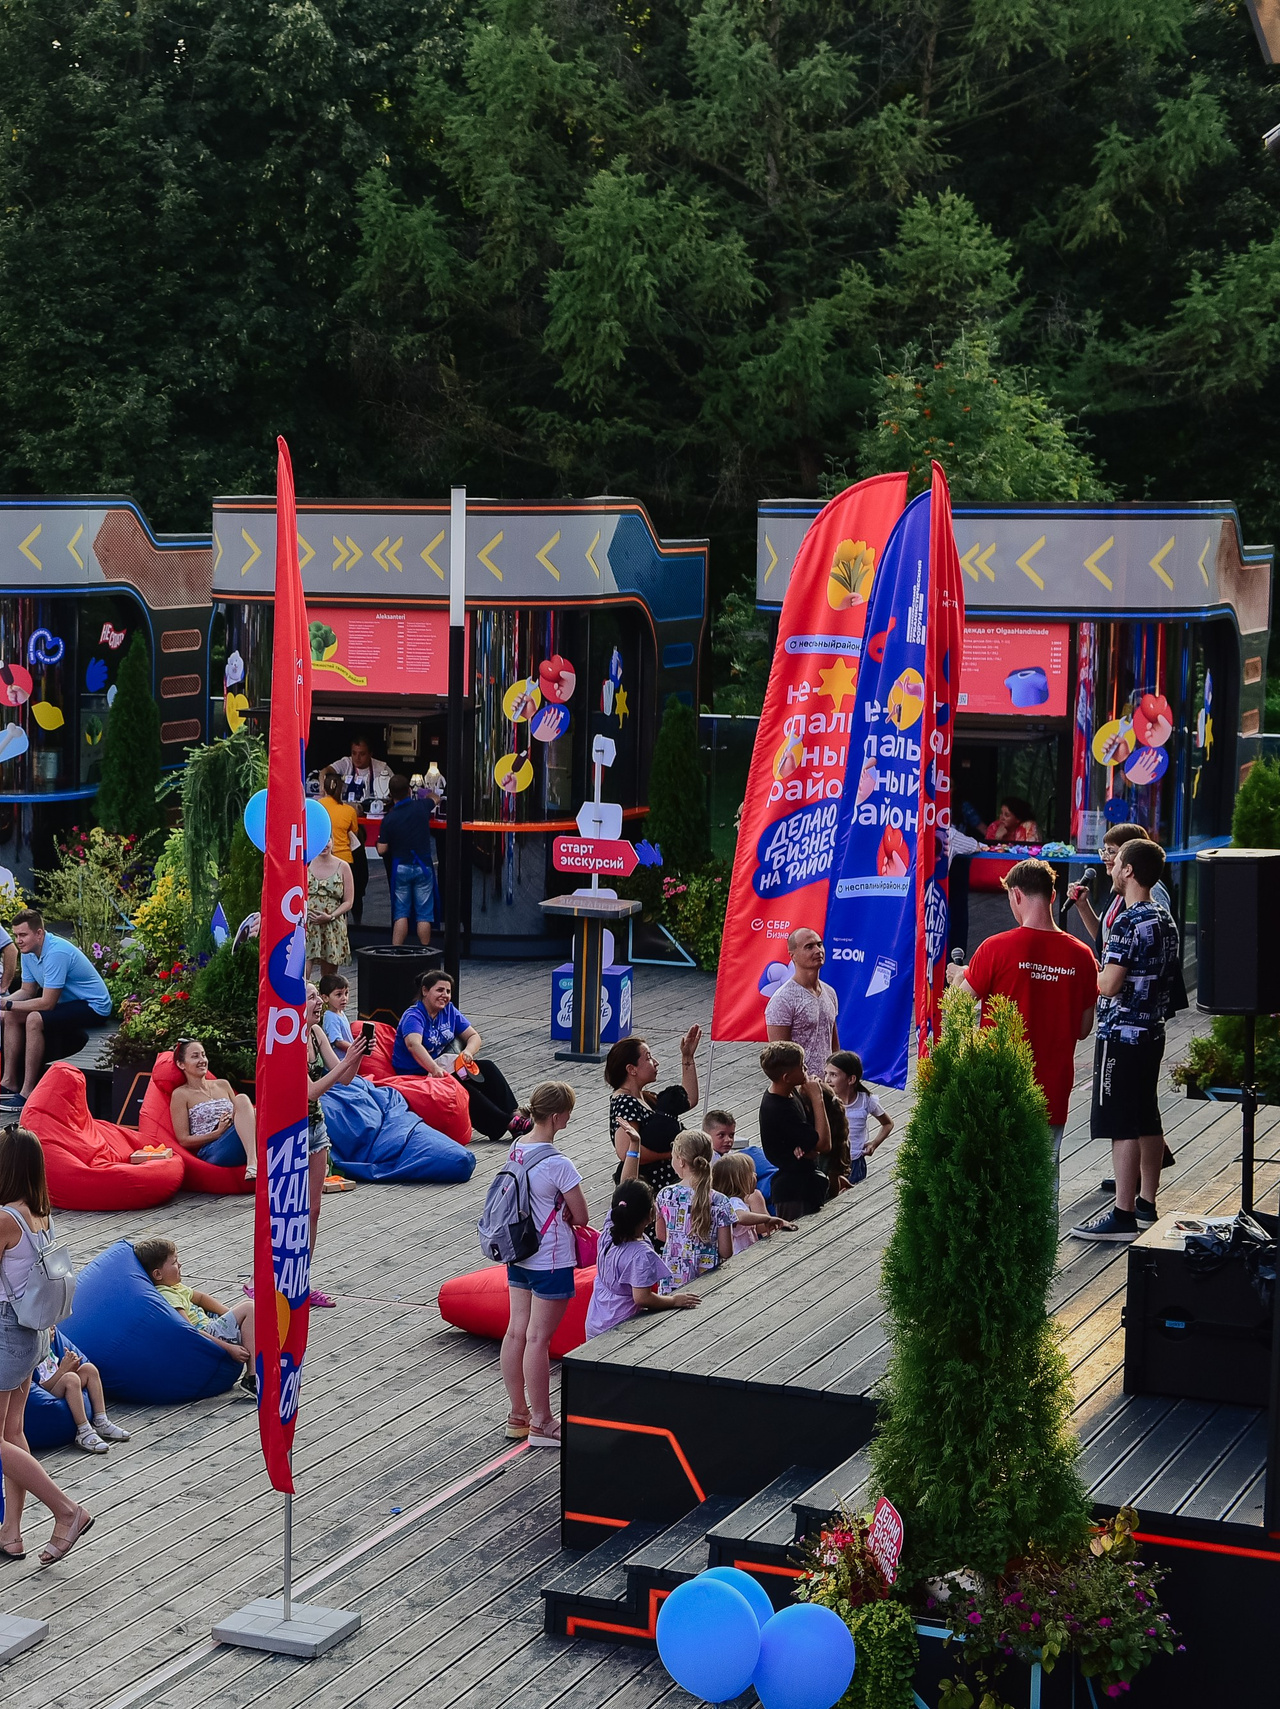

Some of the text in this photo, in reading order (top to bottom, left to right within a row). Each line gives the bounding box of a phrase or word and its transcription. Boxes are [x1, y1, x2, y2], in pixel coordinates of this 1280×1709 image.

[765, 804, 837, 862] ДЕЛАЮ
[560, 843, 594, 856] старт
[560, 856, 624, 870] экскурсий
[760, 870, 781, 891] НА
[766, 919, 790, 930] СБЕР
[1104, 1058, 1116, 1097] Slazenger
[874, 1503, 901, 1544] ДЕЛАЮ
